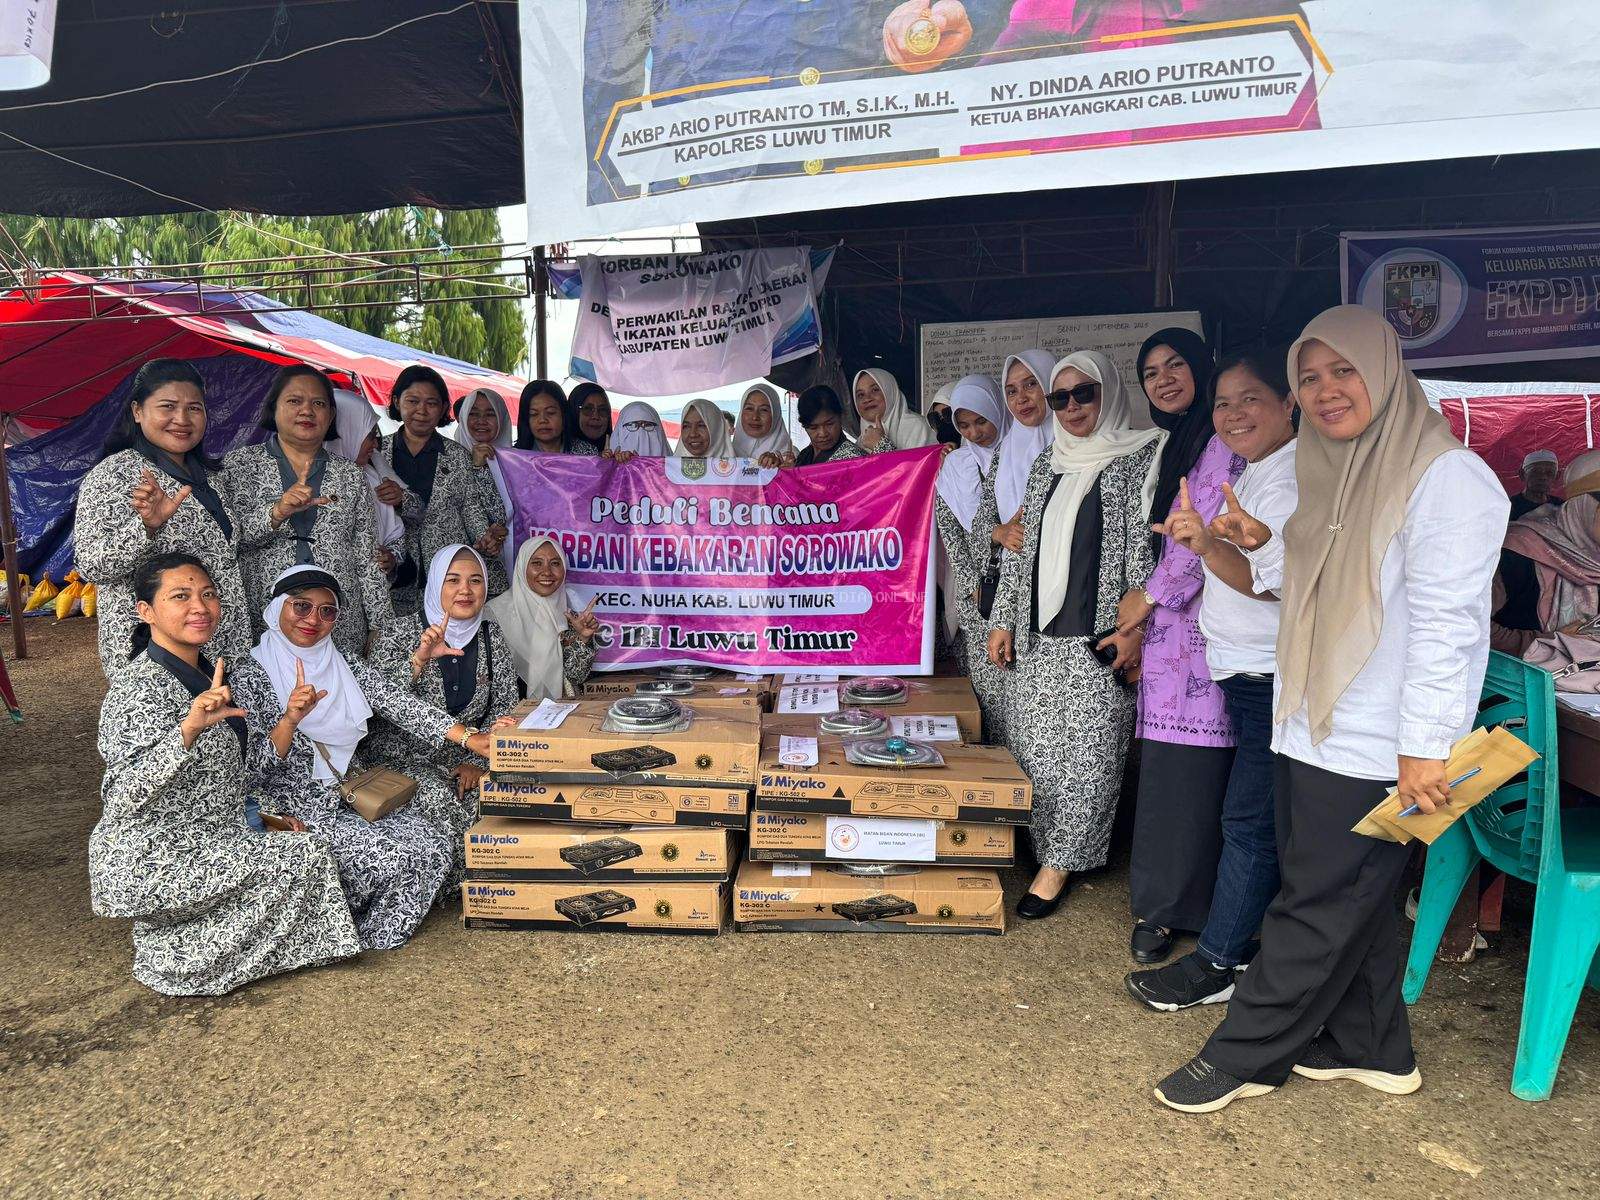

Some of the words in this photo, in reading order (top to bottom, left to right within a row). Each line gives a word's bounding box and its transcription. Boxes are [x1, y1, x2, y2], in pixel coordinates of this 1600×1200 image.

[991, 84, 1023, 102] NY.
[1029, 73, 1094, 98] DINDA
[1098, 68, 1151, 89] ARIO
[1156, 55, 1276, 83] PUTRANTO
[970, 111, 1023, 126] KETUA
[1026, 96, 1144, 121] BHAYANGKARI
[1147, 92, 1187, 108] CAB.
[1191, 87, 1240, 104] LUWU
[1245, 81, 1298, 99] TIMUR
[620, 127, 664, 148] AKBP
[669, 118, 710, 140] ARIO
[714, 103, 813, 131] PUTRANTO
[818, 100, 851, 118] TM,
[856, 95, 908, 113] S.I.K.,
[915, 91, 955, 108] M.H.
[674, 134, 767, 163] KAPOLRES
[773, 127, 827, 148] LUWU
[832, 122, 892, 143] TIMUR
[1387, 264, 1436, 281] FKPPI
[1485, 258, 1546, 272] KELUARGA
[1548, 256, 1587, 269] BESAR
[1486, 276, 1586, 320] FKPPI
[616, 306, 707, 329] PERWAKILAN
[624, 325, 676, 341] IKATAN
[591, 495, 698, 526] Peduli
[709, 496, 840, 527] Bencana
[631, 532, 777, 575] KEBAKARAN
[779, 526, 904, 575] SOROWAKO
[596, 592, 635, 607] KEC.
[641, 593, 688, 608] NUHA
[692, 594, 732, 609] KAB.
[738, 595, 785, 609] LUWU
[788, 593, 836, 608] TIMUR
[668, 625, 757, 652] Luwu
[763, 624, 858, 653] Timur
[596, 684, 630, 694] Miyako
[507, 739, 550, 751] Miyako
[496, 782, 547, 796] Miyako
[774, 776, 826, 790] Miyako
[767, 815, 807, 827] Miyako
[479, 835, 519, 846] Miyako
[477, 886, 516, 898] Miyako
